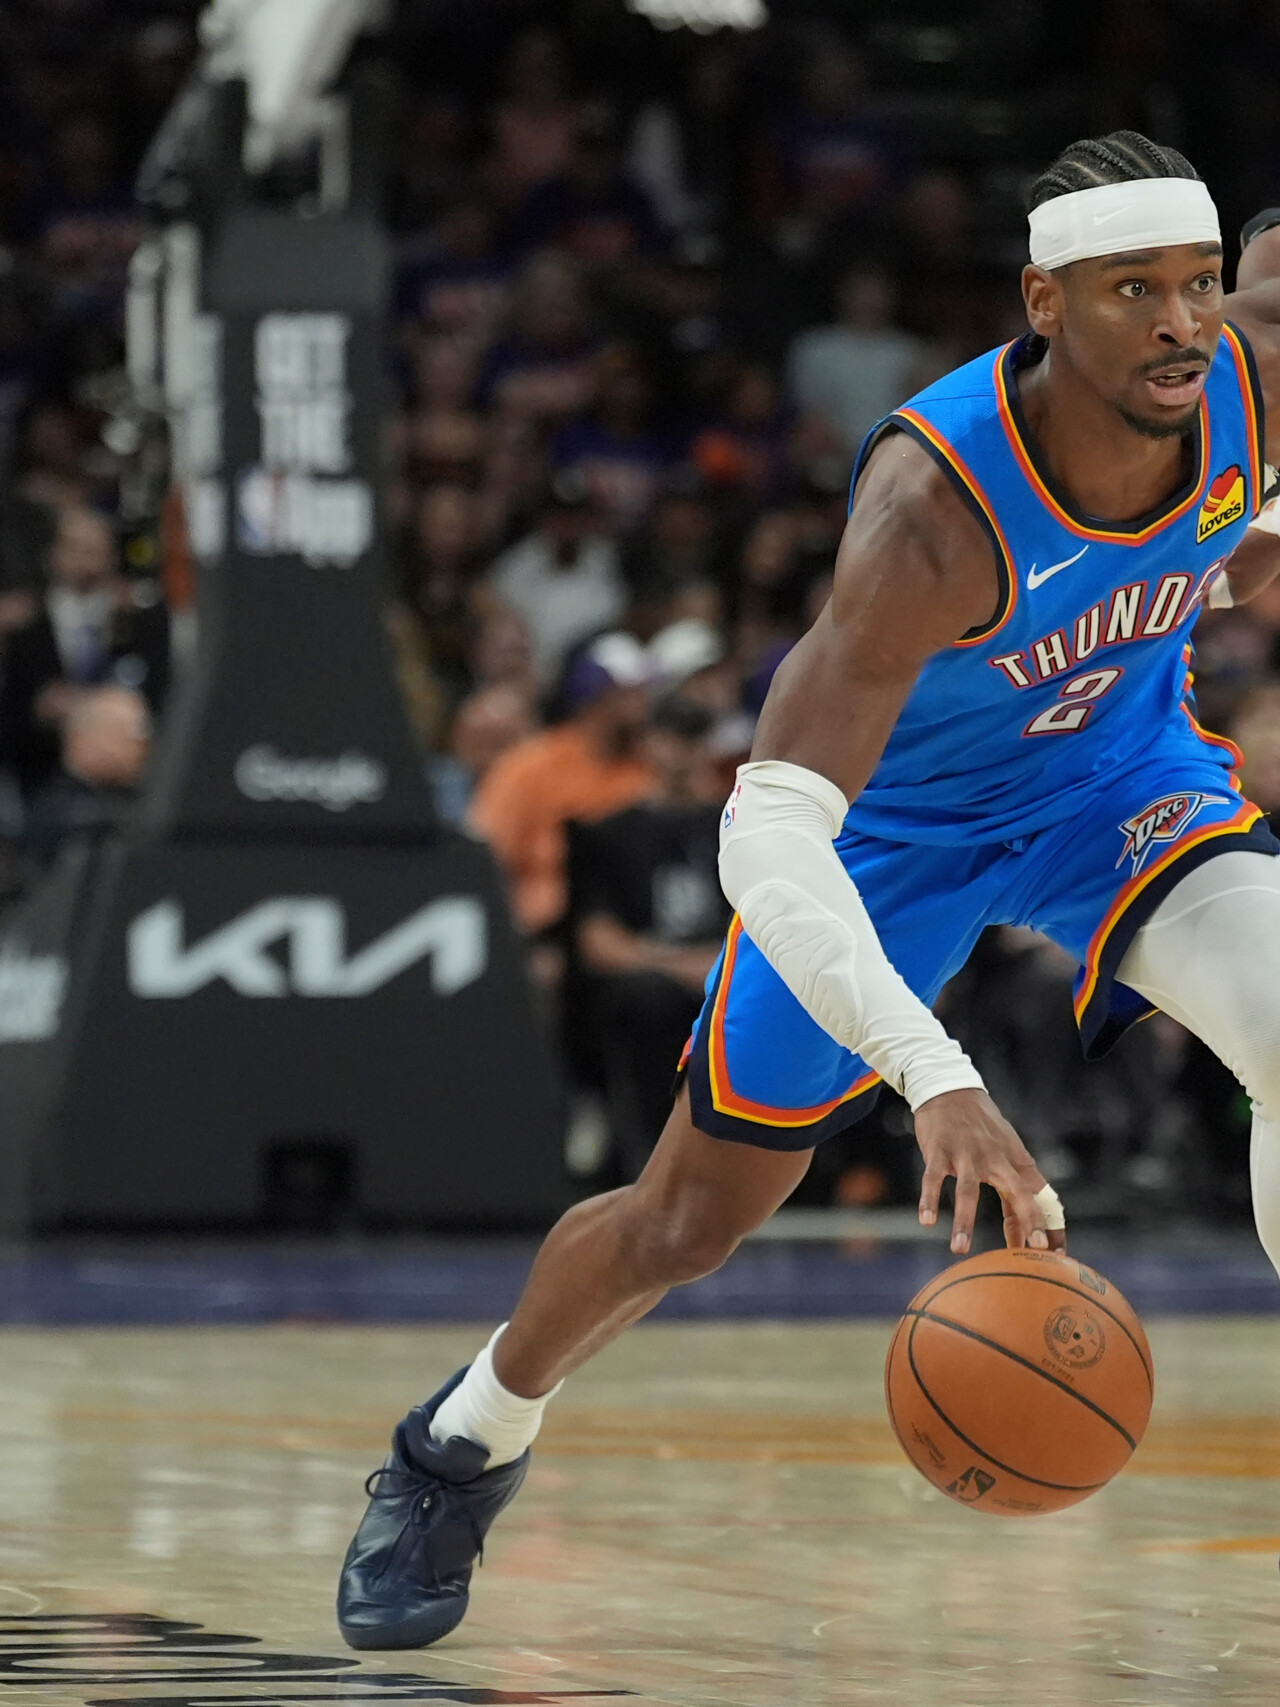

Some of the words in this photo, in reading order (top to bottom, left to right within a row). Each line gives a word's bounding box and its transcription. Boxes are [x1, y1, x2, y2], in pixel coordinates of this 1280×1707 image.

[988, 554, 1229, 690] THUNDE
[1021, 667, 1125, 738] 2
[1132, 797, 1185, 856] OKC
